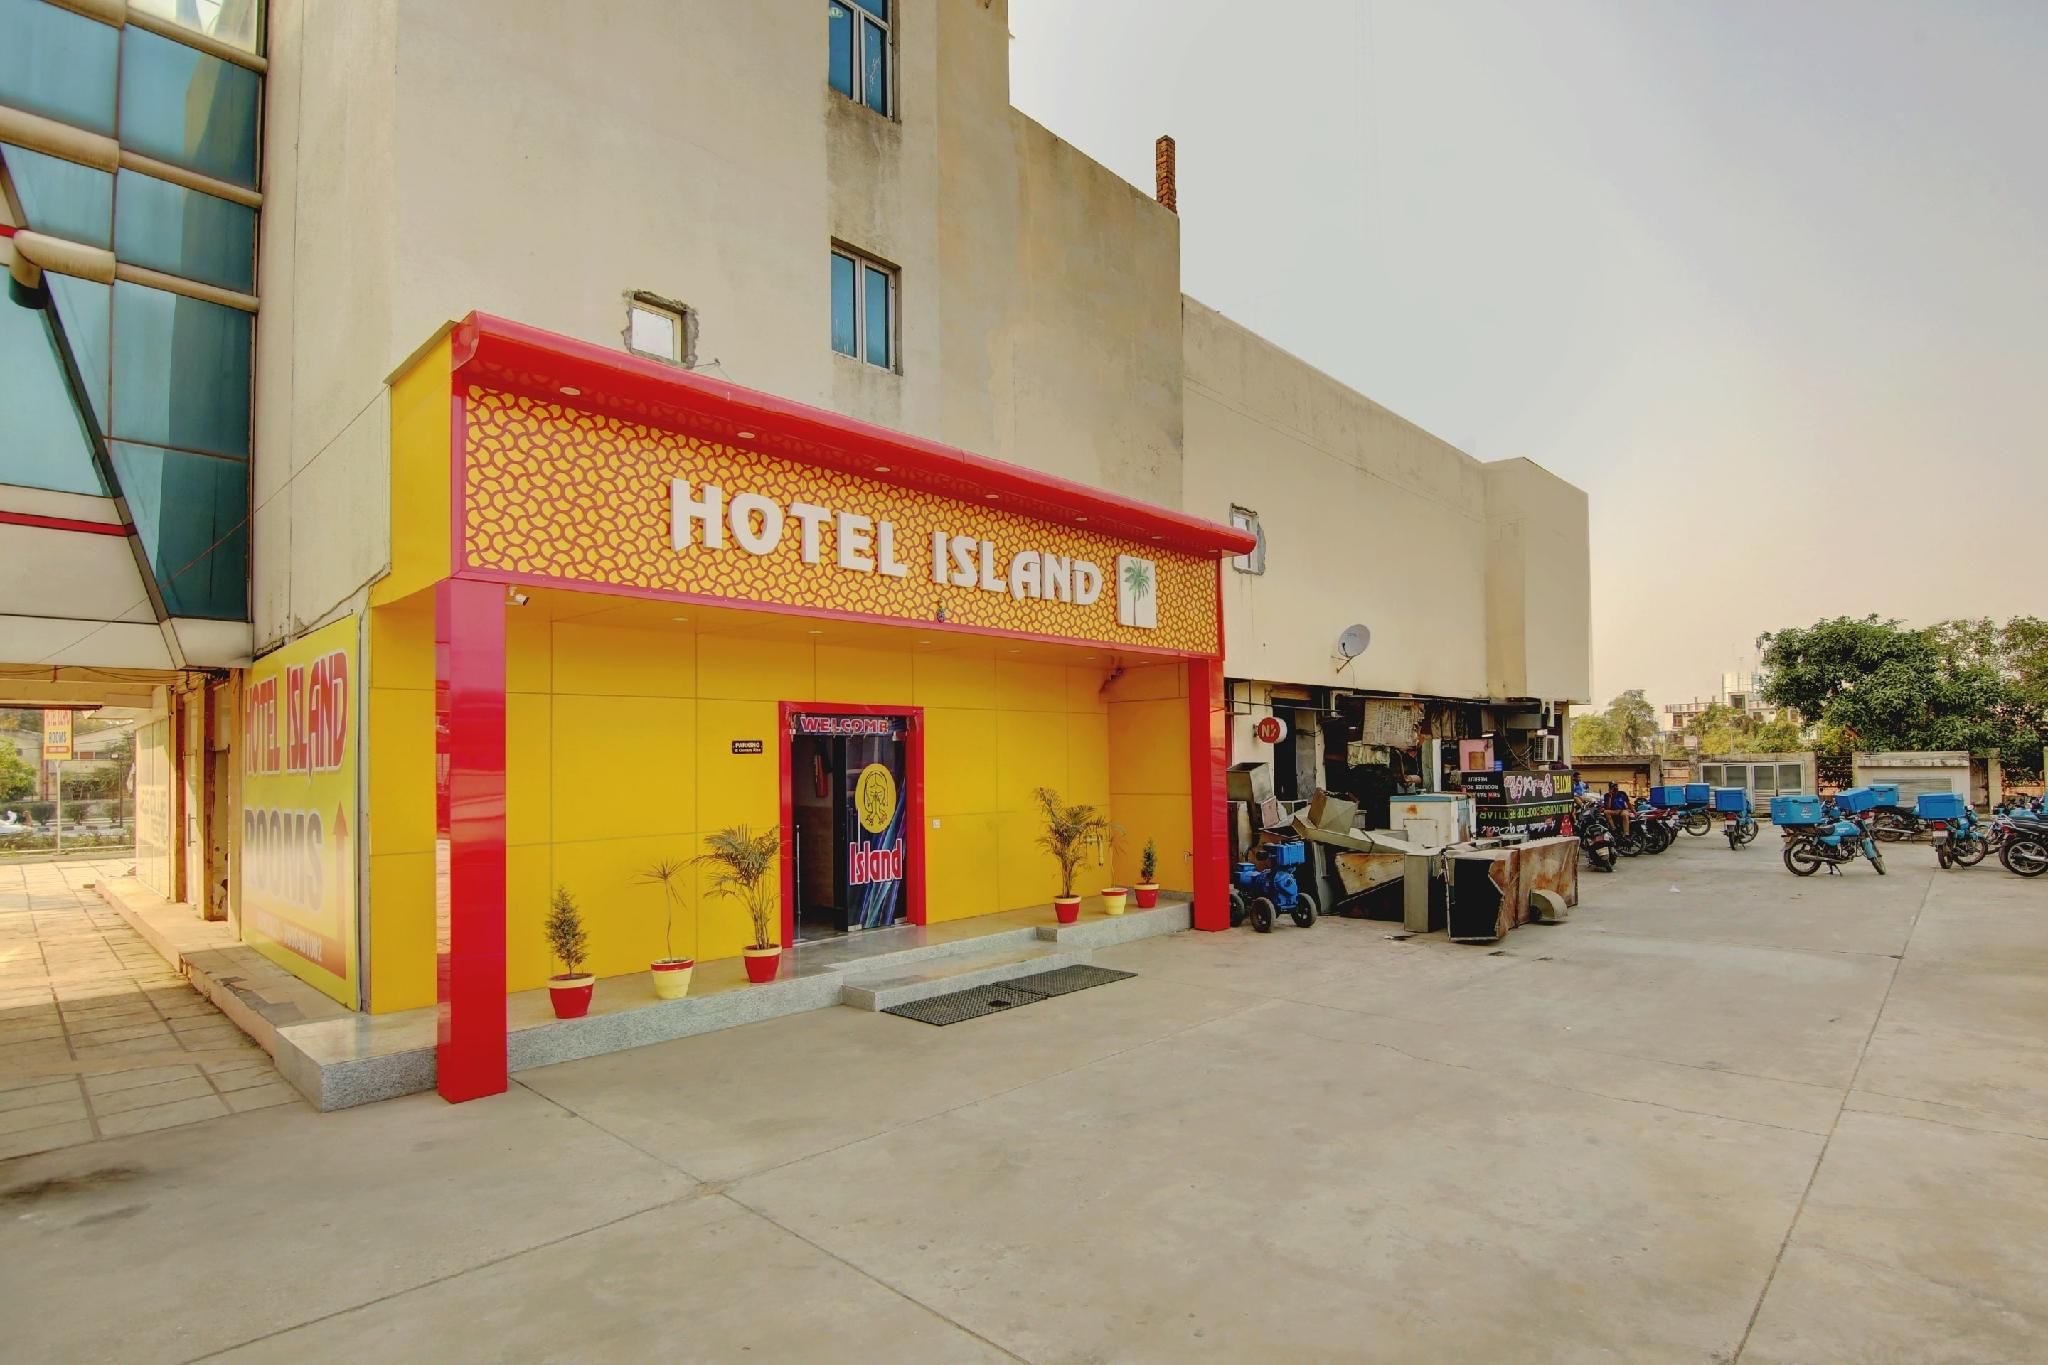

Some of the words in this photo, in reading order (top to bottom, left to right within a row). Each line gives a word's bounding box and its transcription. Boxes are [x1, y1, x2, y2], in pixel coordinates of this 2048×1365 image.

[670, 478, 909, 578] HOTEL
[931, 529, 1104, 606] ISLAND
[244, 675, 280, 776] HOTEL
[285, 651, 348, 780] ISLAND
[1553, 775, 1572, 794] HOTEL
[243, 808, 324, 914] ROOMS
[849, 837, 903, 885] Island
